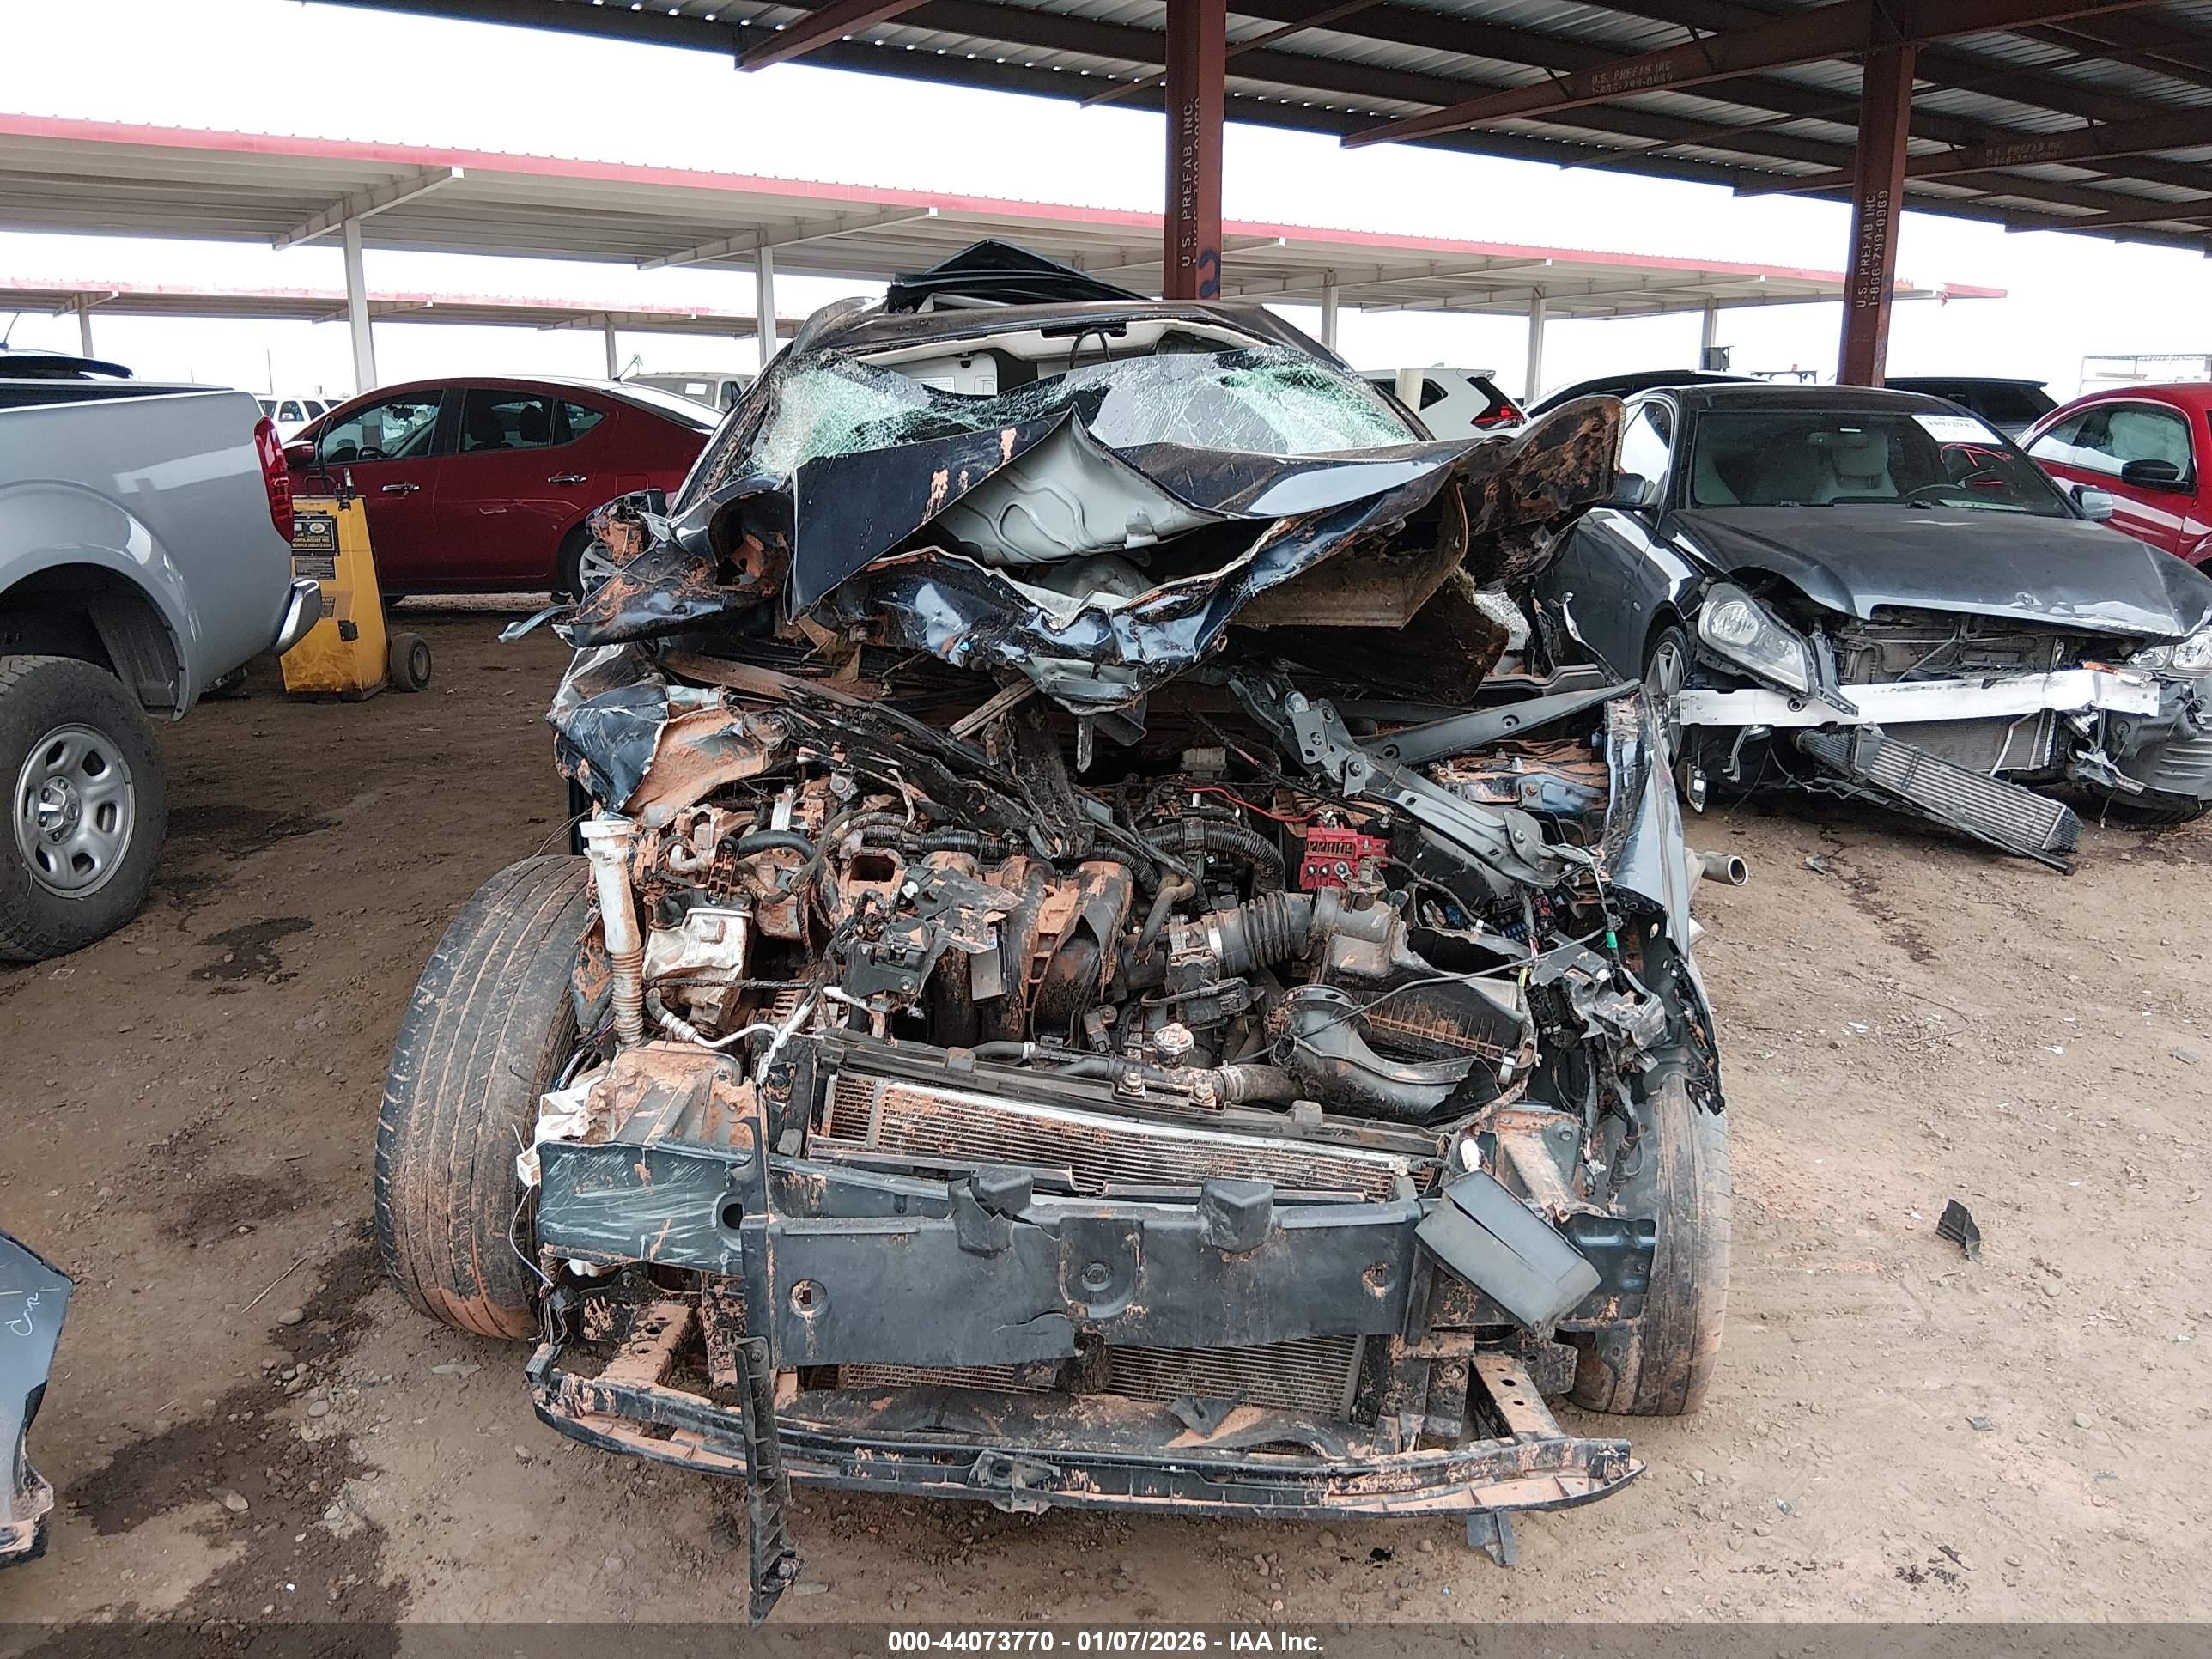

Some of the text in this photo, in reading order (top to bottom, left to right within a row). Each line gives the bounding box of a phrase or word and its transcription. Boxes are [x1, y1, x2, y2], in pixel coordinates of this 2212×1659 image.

[1182, 145, 1193, 220] PREFAB
[1860, 223, 1873, 276] PREFAB
[1869, 190, 1888, 307] 1-866-799-0969
